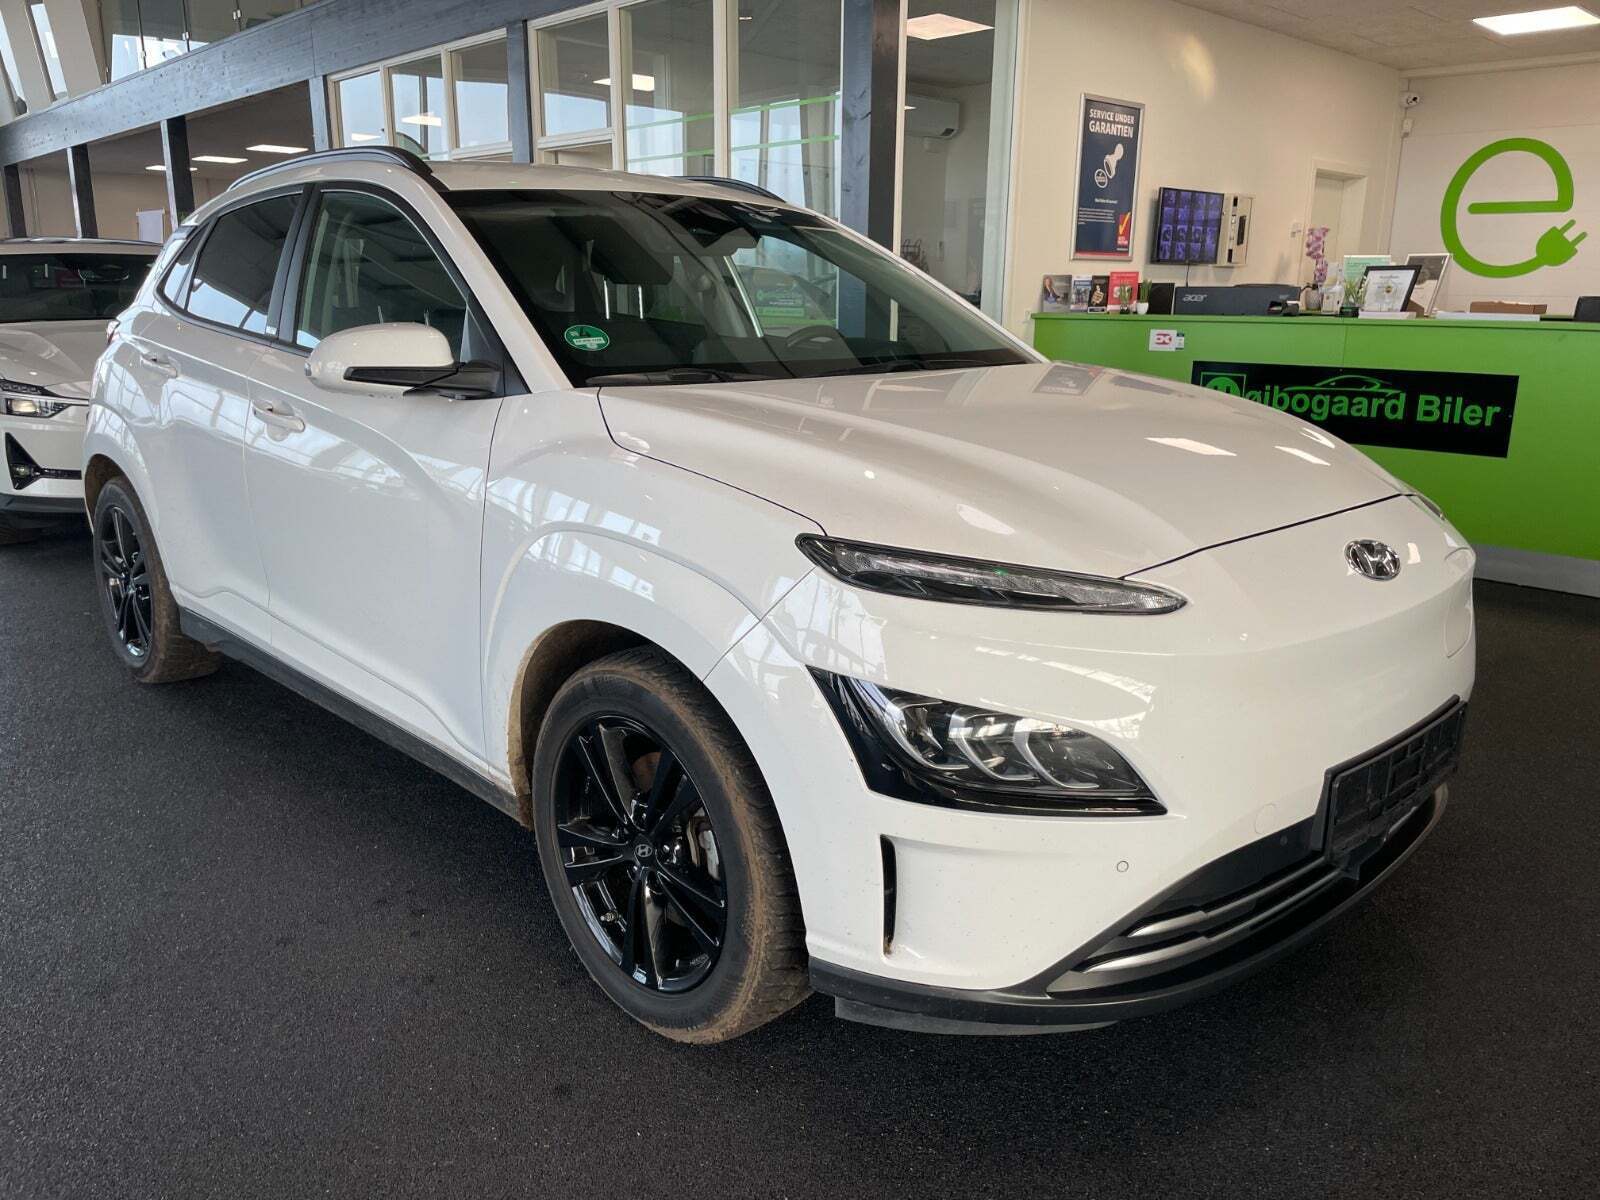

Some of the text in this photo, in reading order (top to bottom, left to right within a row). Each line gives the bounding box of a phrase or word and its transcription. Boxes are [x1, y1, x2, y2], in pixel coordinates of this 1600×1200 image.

[1089, 109, 1135, 124] SERVICE UNDER
[1089, 121, 1134, 138] GARANTIEN
[1183, 294, 1208, 302] acer
[1416, 395, 1501, 426] Biler
